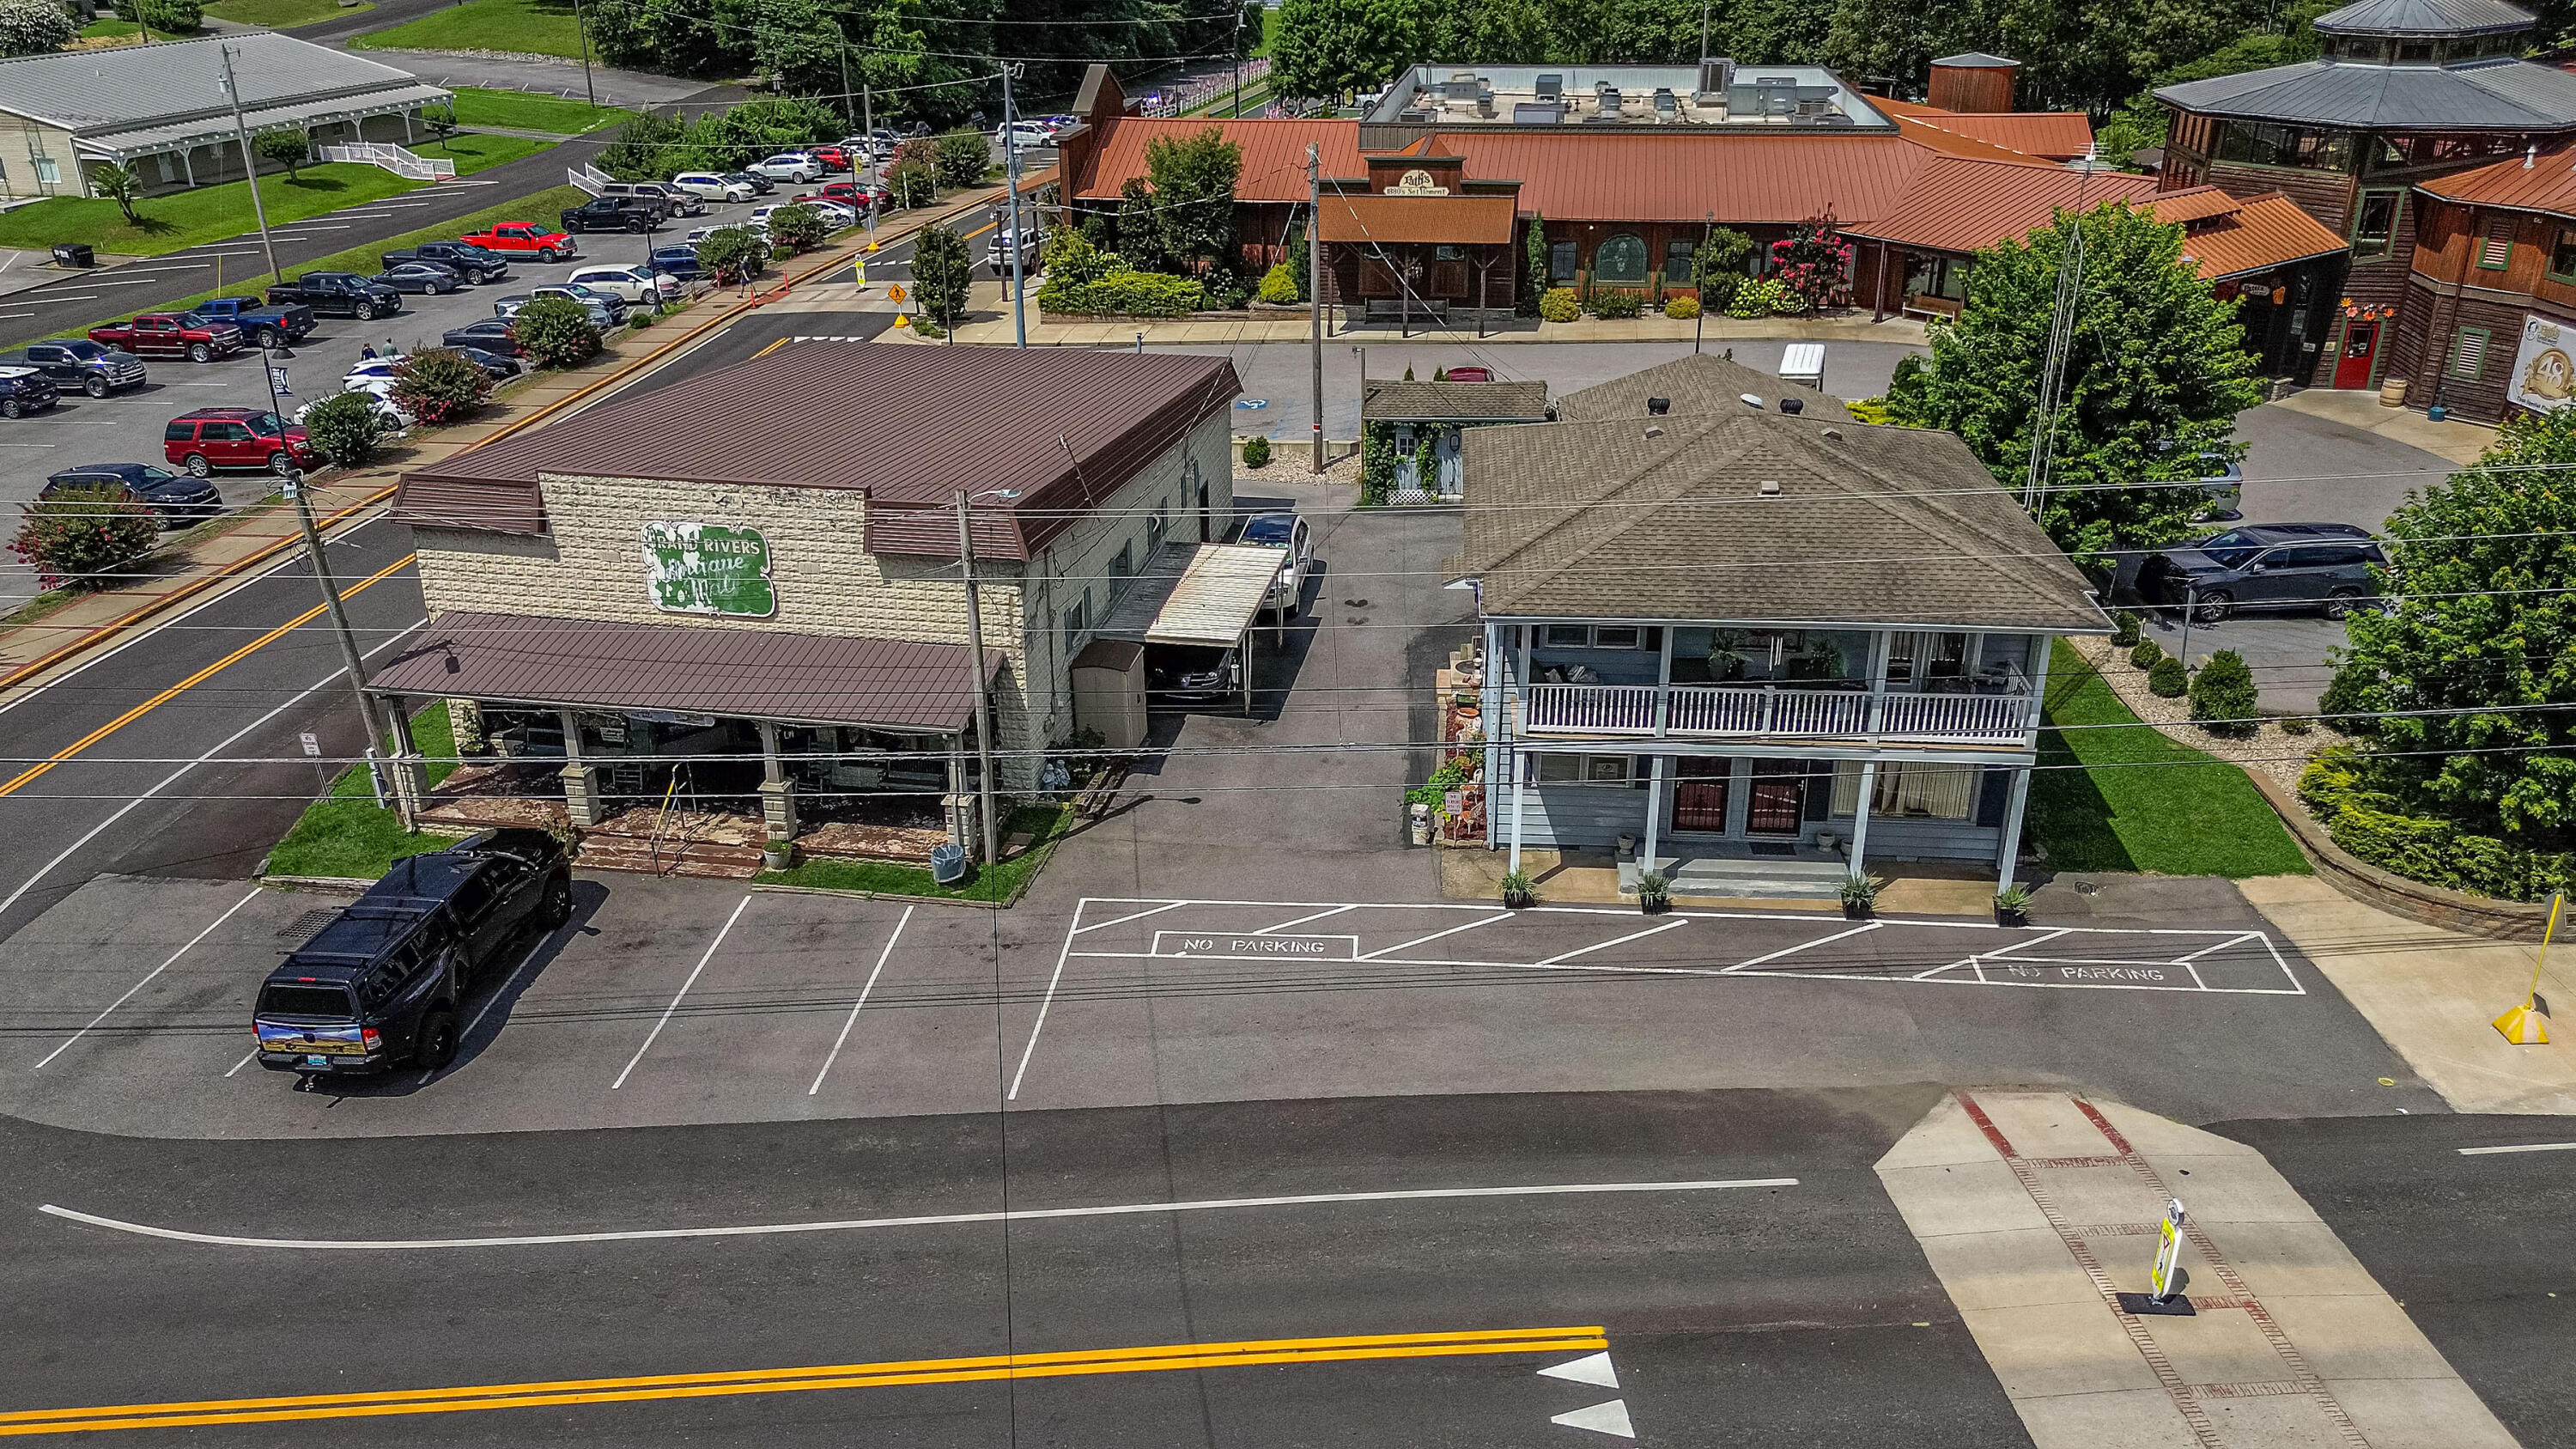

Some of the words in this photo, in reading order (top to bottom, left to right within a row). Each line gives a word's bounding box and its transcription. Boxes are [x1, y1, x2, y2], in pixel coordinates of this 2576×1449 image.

[704, 539, 761, 555] RIVERS
[1184, 939, 1213, 950] NO
[1231, 940, 1325, 953] PARKING
[2007, 965, 2040, 977] NO
[2061, 967, 2164, 980] PARKING
